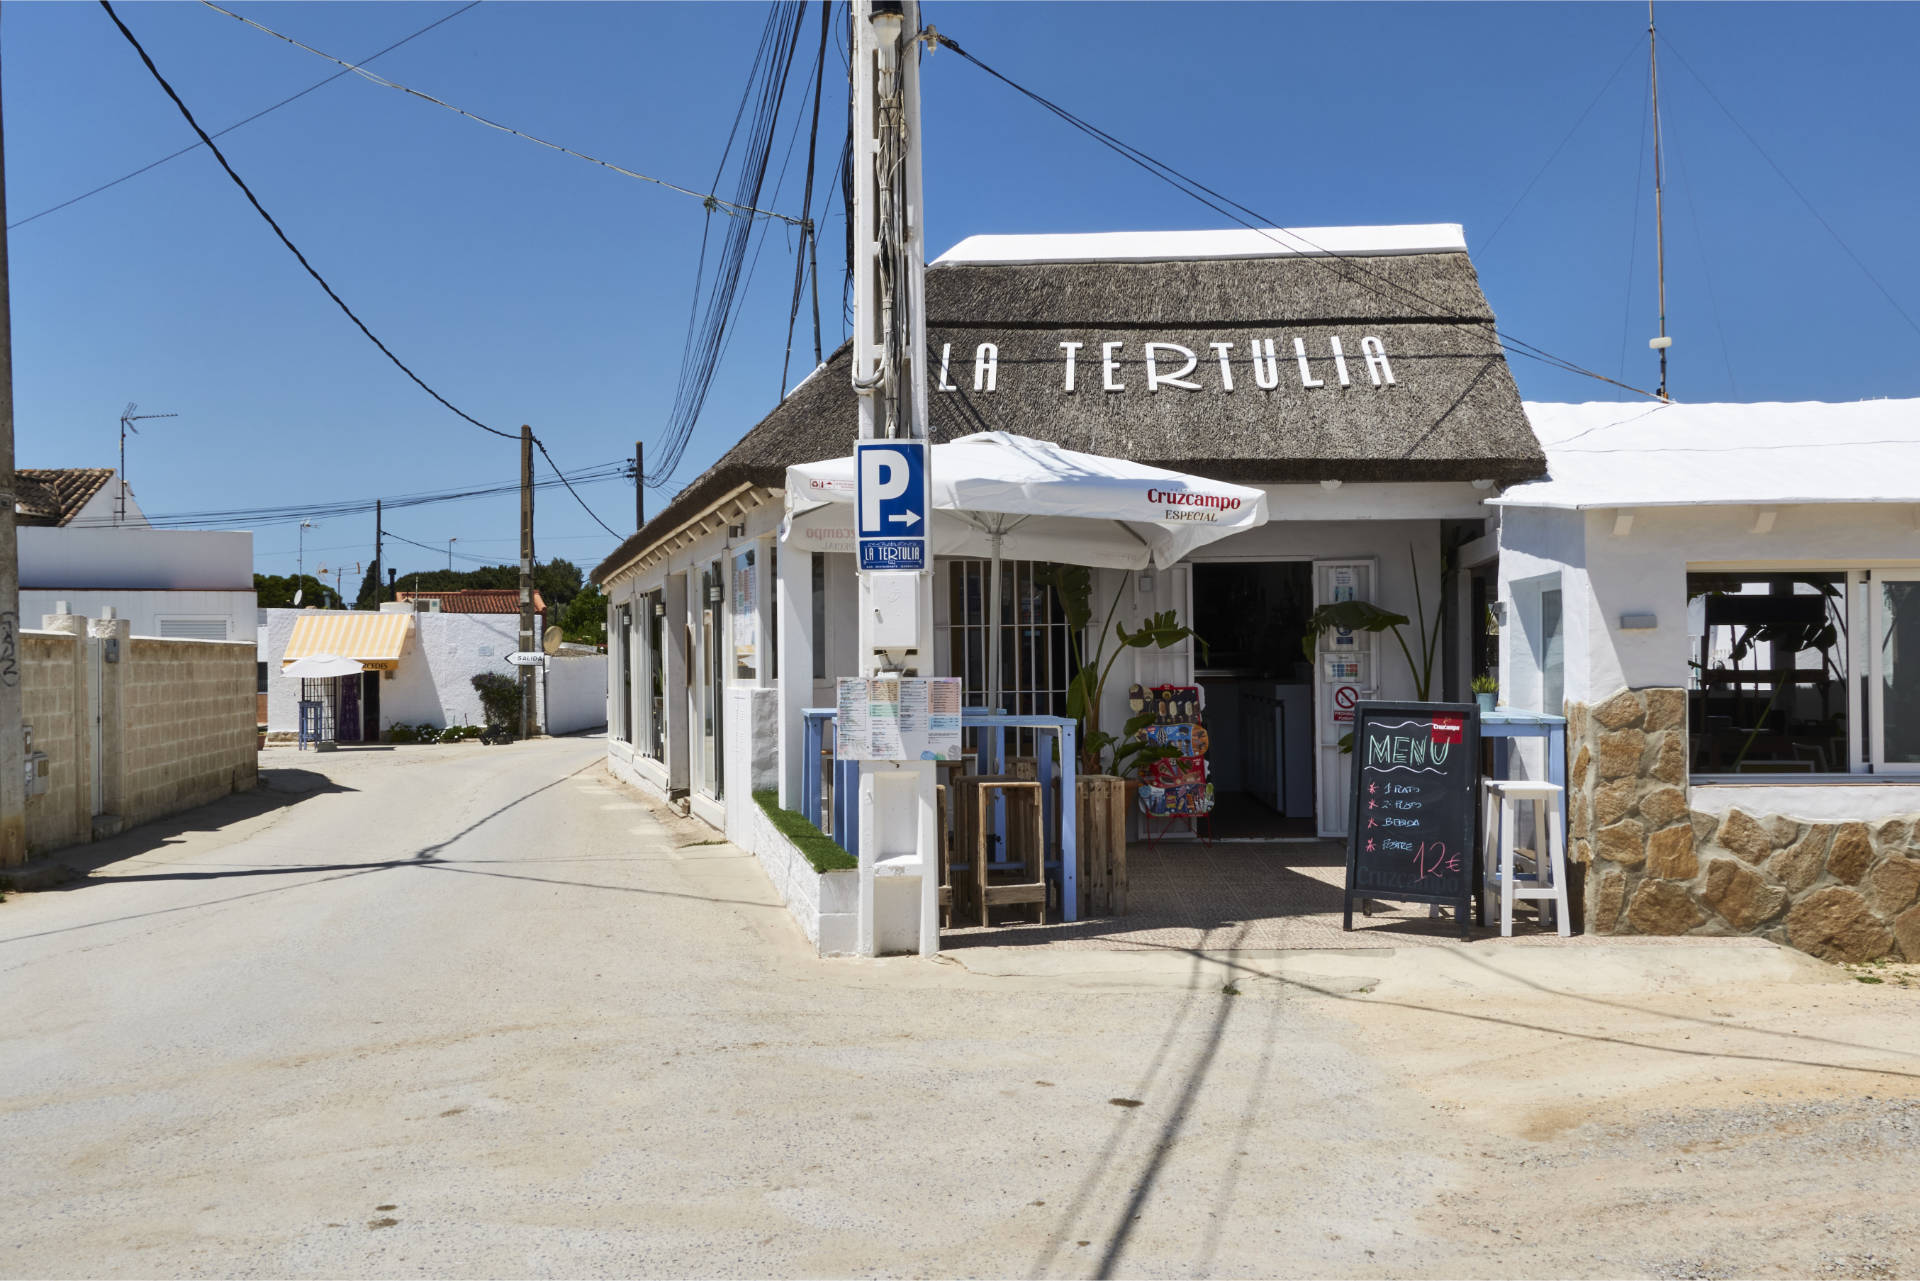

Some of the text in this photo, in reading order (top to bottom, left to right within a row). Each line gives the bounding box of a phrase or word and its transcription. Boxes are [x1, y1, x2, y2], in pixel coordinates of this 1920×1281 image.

[938, 335, 1397, 394] LA TERTULIA
[861, 449, 910, 532] P
[1147, 487, 1242, 512] Cruzcampo
[1165, 509, 1218, 522] ESPECIAL
[864, 546, 921, 561] LA TERTULIA
[1368, 733, 1450, 766] MENU
